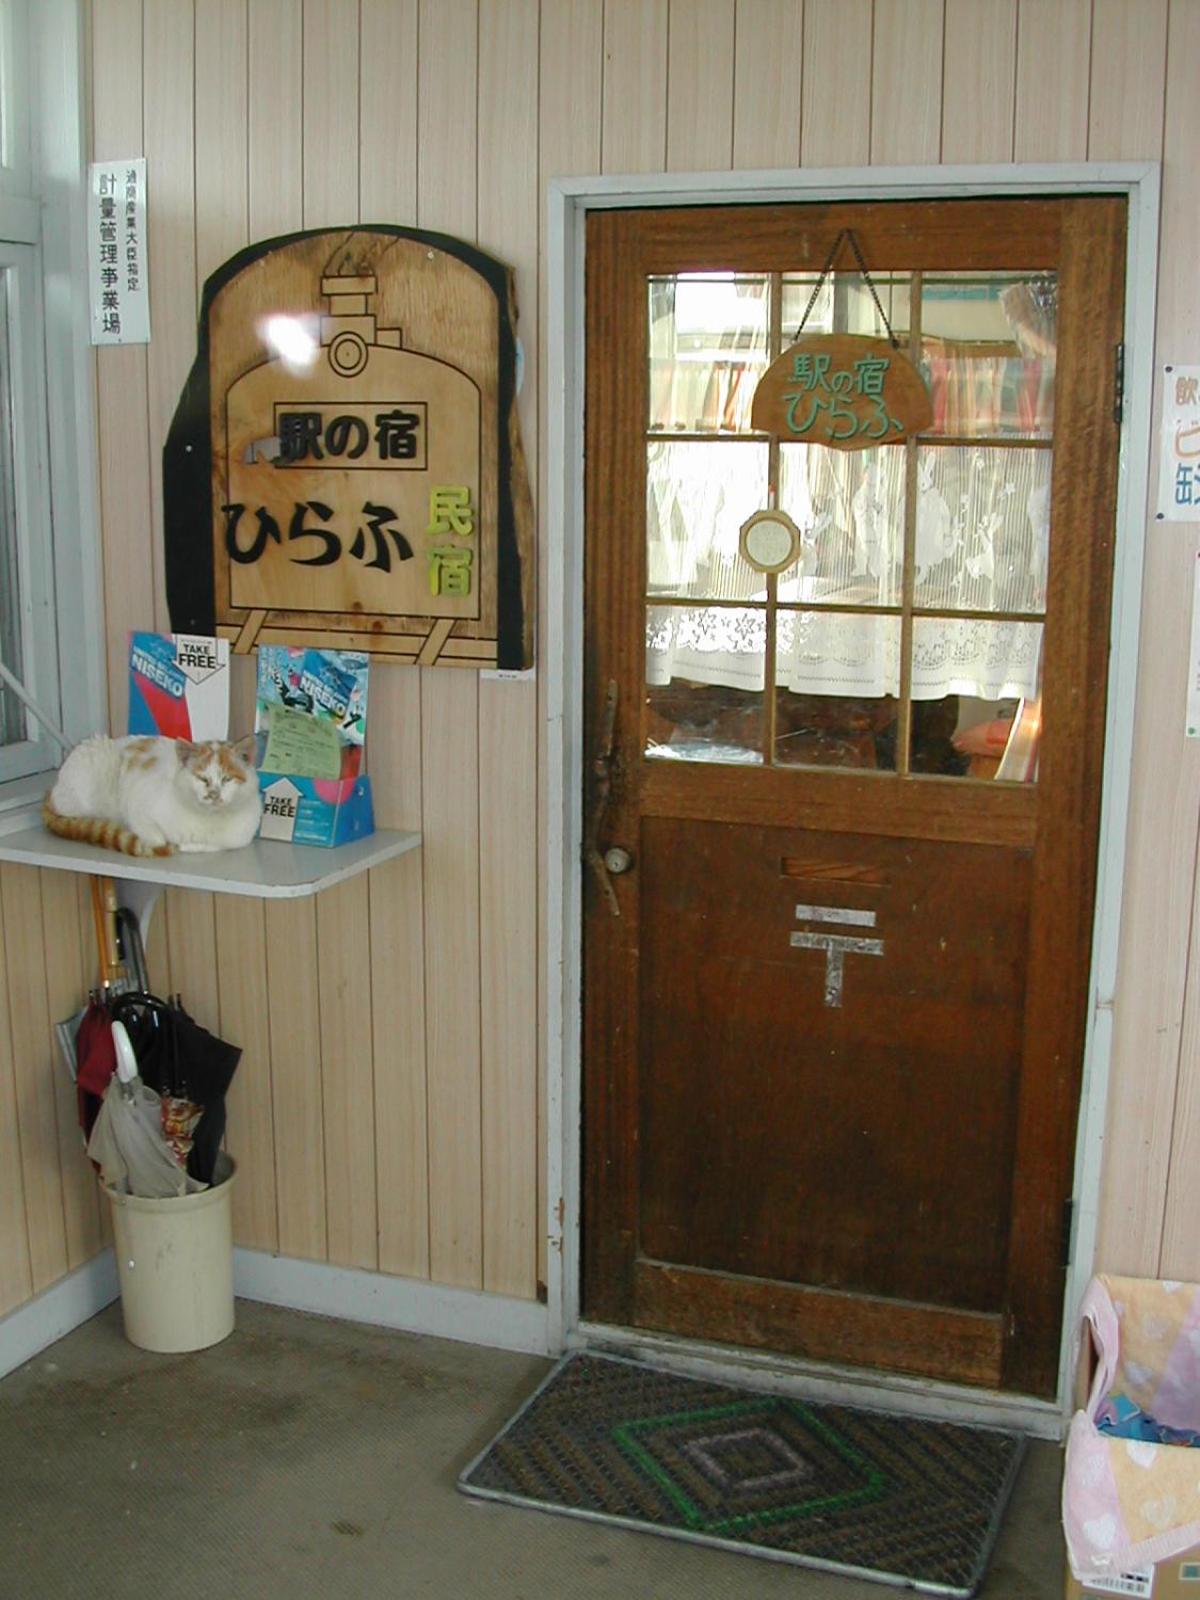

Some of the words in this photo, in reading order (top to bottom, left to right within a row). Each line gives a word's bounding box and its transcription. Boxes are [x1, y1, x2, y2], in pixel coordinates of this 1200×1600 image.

[99, 173, 121, 335] 計量管理事業場
[788, 352, 889, 395] 駅の宿
[278, 410, 420, 460] 駅の宿
[783, 391, 904, 440] ひらふ
[221, 500, 414, 573] ひらふ
[427, 485, 474, 597] 民宿
[178, 654, 217, 669] FREE
[183, 644, 211, 655] TAKE
[130, 653, 183, 698] NISEKO
[300, 676, 346, 717] NISEKO
[264, 804, 296, 818] FREE
[270, 796, 293, 805] TAKE
